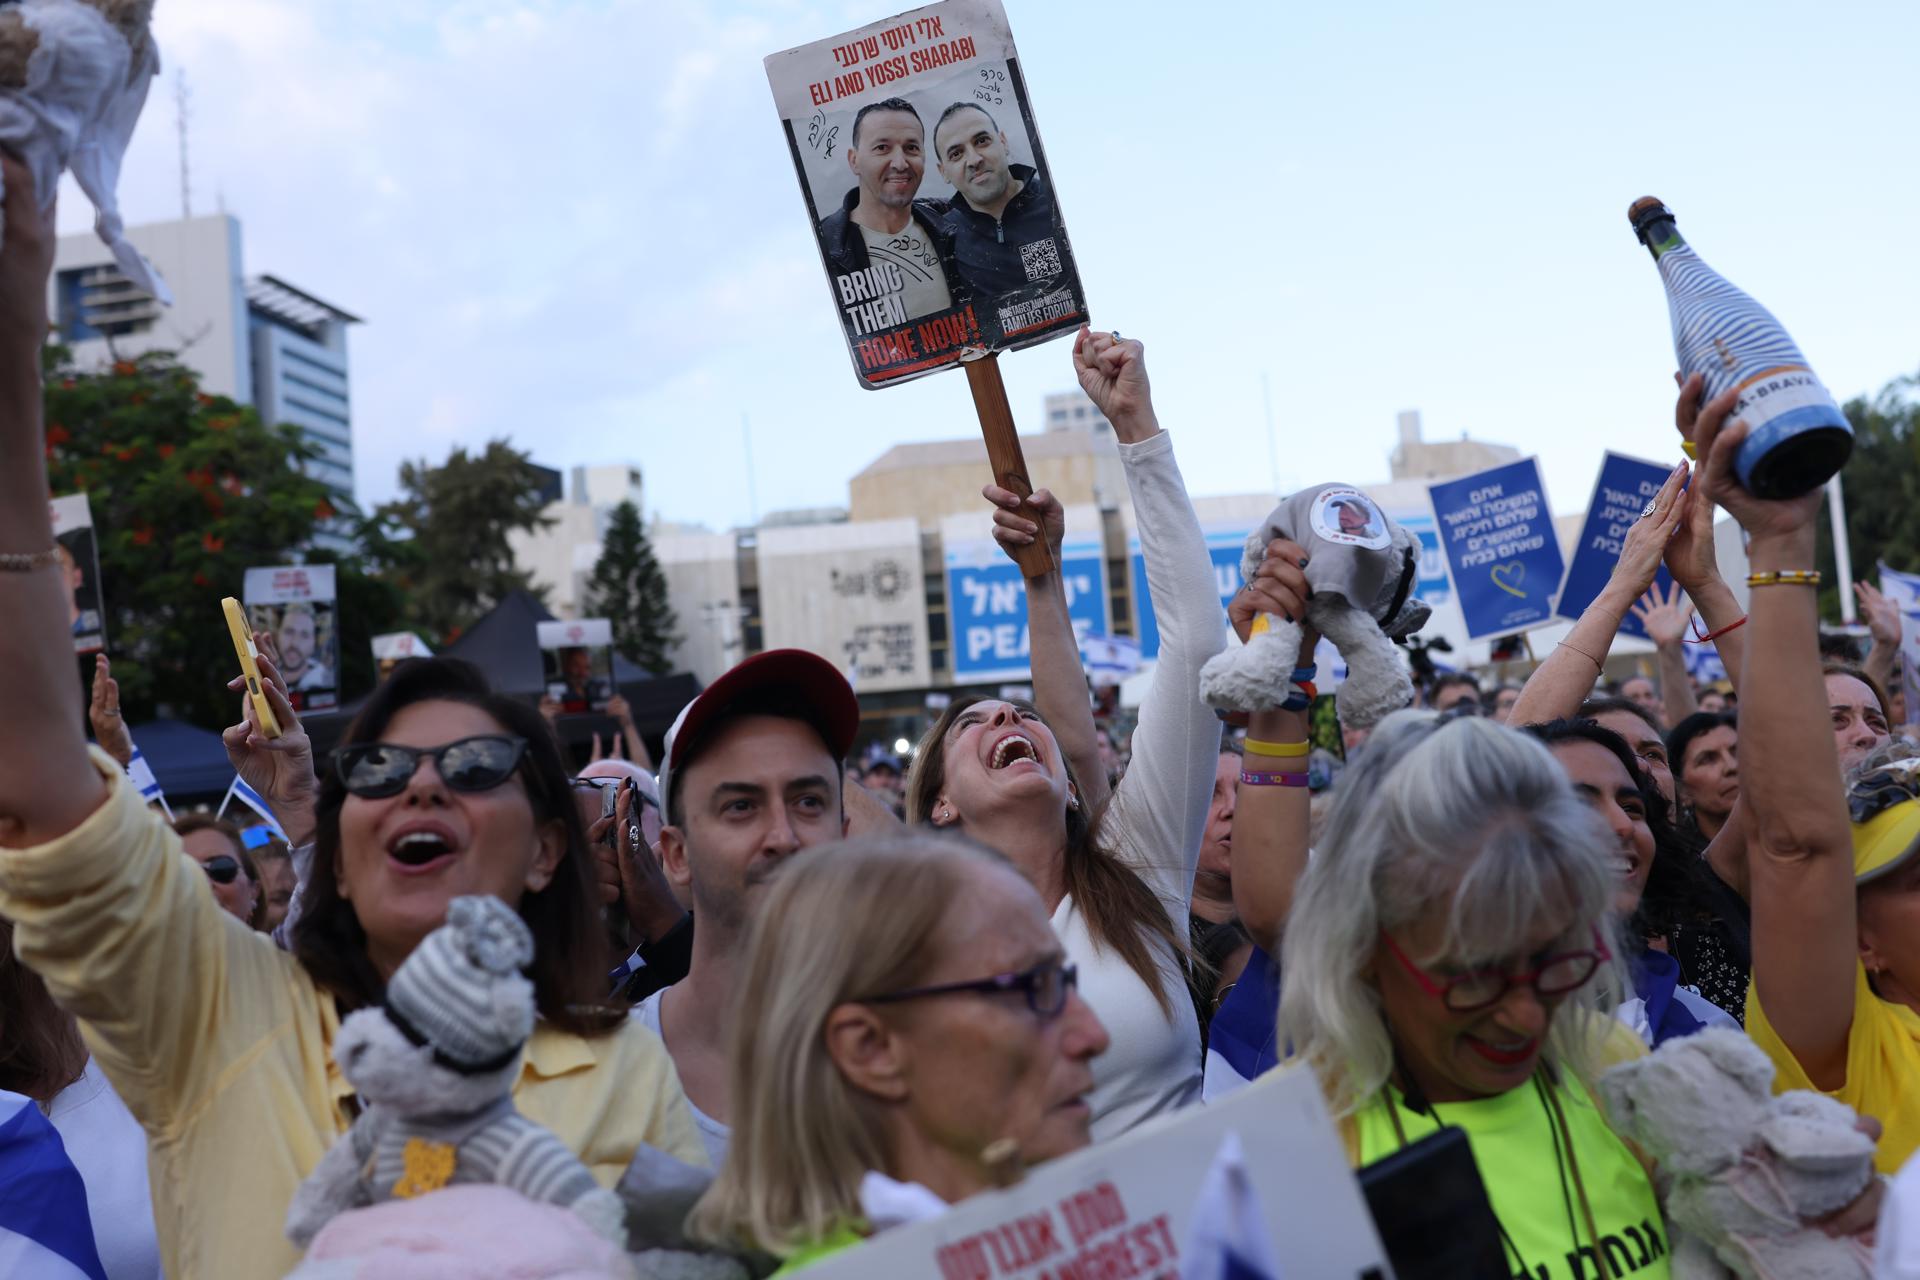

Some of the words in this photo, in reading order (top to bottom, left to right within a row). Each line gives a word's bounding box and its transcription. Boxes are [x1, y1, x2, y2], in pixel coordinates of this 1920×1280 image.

[880, 24, 916, 50] ויוסי
[916, 16, 944, 40] אלי
[833, 36, 880, 67] שרעבי
[809, 80, 833, 106] ELI
[835, 71, 865, 99] AND
[865, 55, 910, 87] YOSSI
[910, 36, 976, 73] SHARABI
[837, 261, 904, 305] BRING
[845, 293, 908, 336] THEM
[998, 301, 1033, 320] HOSTAGES
[1044, 288, 1073, 307] MISSING
[1001, 309, 1043, 334] FAMILIES
[1042, 299, 1077, 321] FORUM
[858, 328, 919, 369] HOME
[918, 304, 981, 353] NOW!
[1470, 484, 1503, 505] אתם
